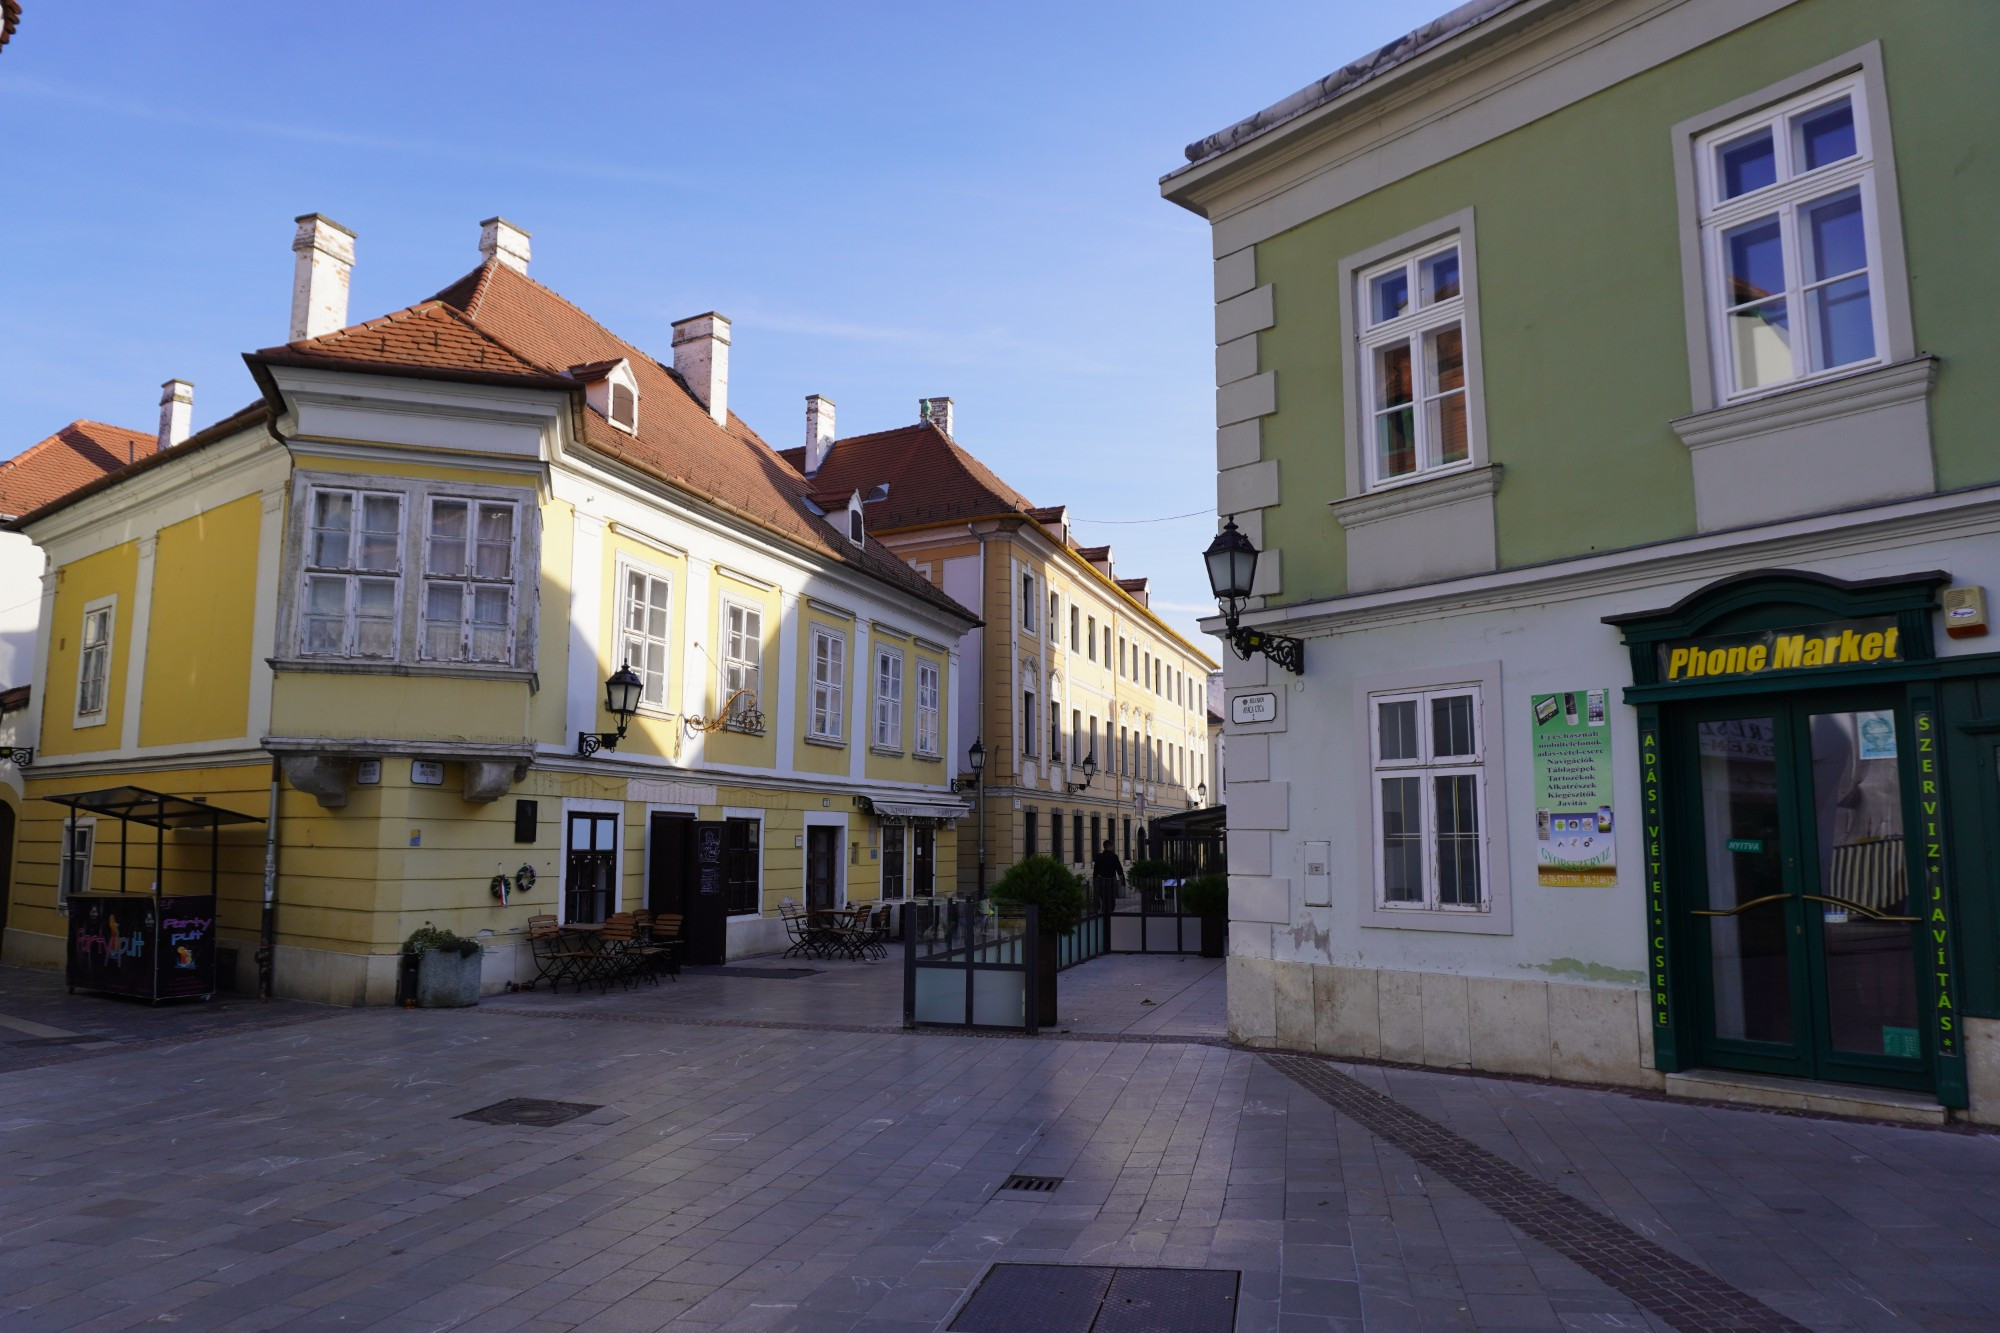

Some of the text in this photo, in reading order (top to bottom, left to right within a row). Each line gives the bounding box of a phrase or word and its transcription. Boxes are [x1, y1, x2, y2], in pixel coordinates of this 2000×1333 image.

[1668, 627, 1899, 679] Phone Market
[1563, 730, 1599, 739] használt
[1538, 740, 1602, 749] mobiltelefonok
[1537, 749, 1605, 757] adás-vétel-csere
[1547, 757, 1595, 766] Navigációk
[1547, 766, 1596, 774] Táblagépek
[1547, 783, 1597, 791] Alkatrészek
[1728, 842, 1760, 851] NYITVA
[1541, 846, 1610, 872] GYORSSZERVIZ
[1918, 717, 1953, 1031] SZERVIZ JAVÍTÁS
[1644, 735, 1668, 1024] ADÁS VÉTEL CSERE
[162, 917, 212, 931] Party
[171, 930, 204, 946] pult
